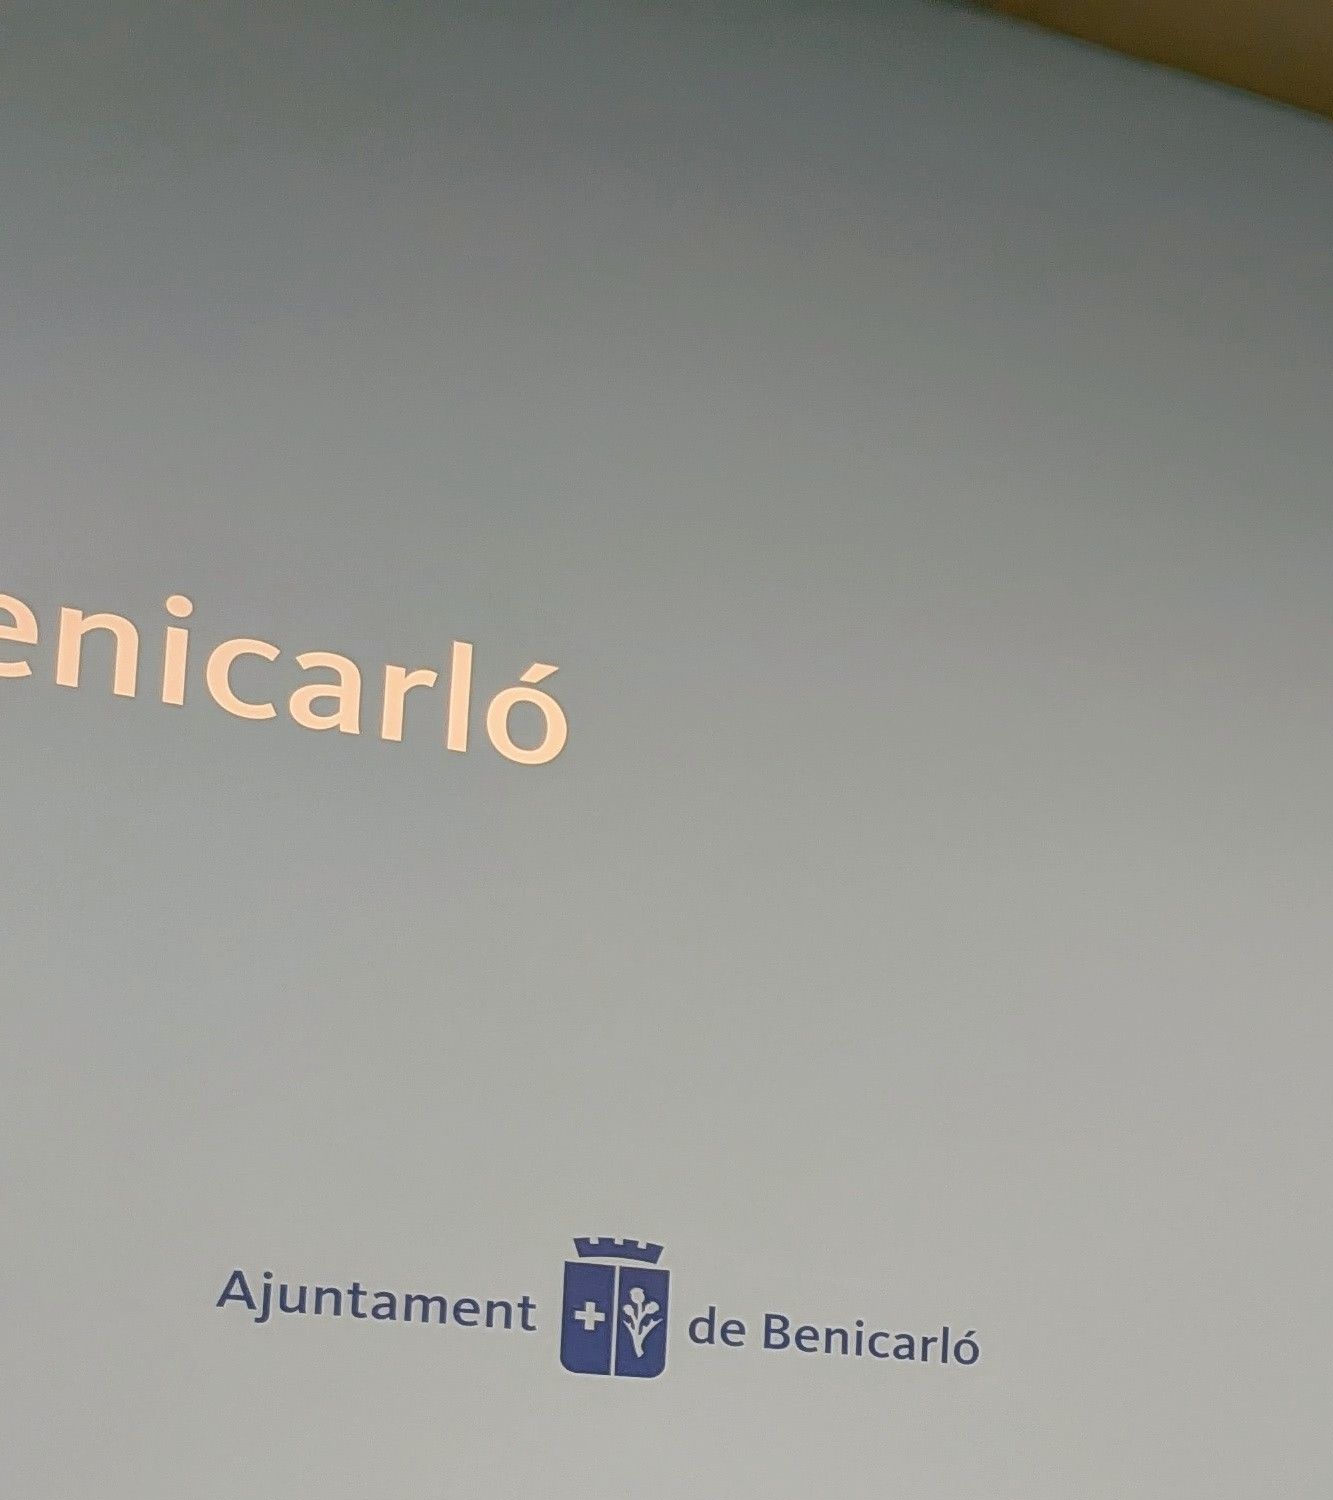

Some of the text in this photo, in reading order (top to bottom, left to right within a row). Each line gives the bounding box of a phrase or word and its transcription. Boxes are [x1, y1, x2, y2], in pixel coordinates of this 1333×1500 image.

[216, 1269, 981, 1366] Ajuntament de Benicarló
